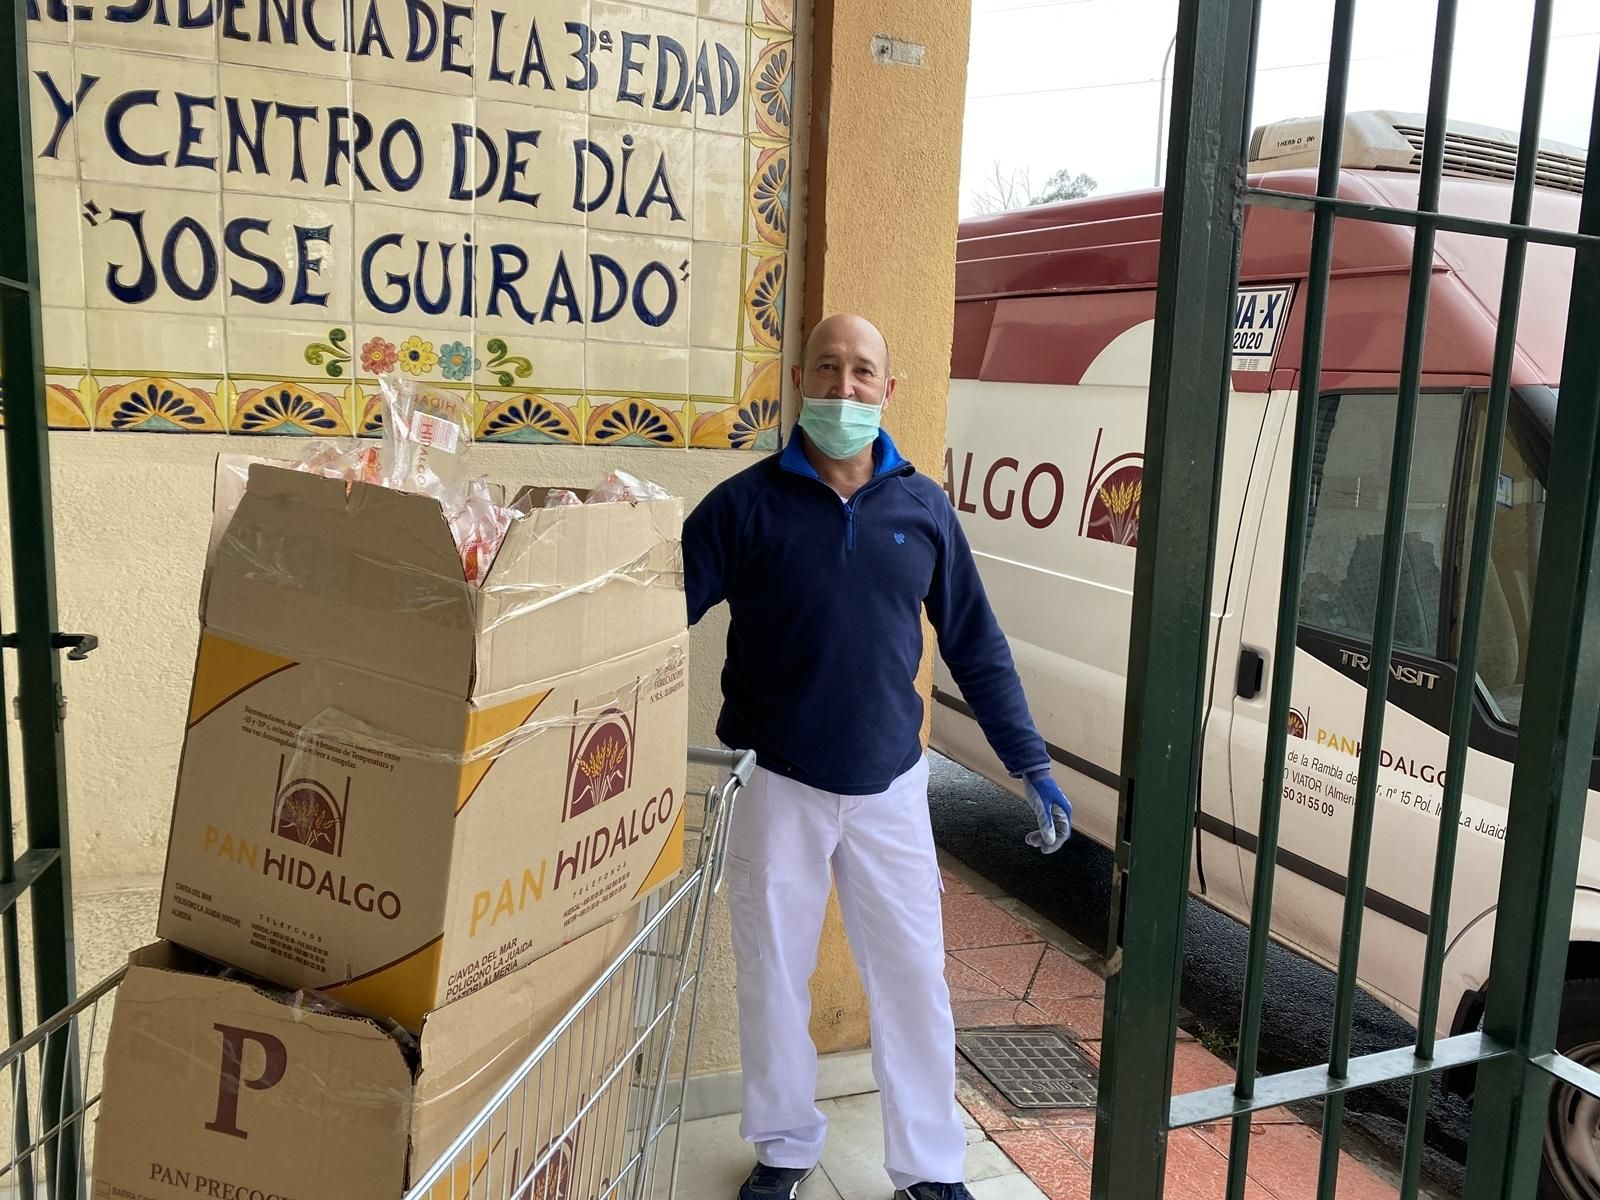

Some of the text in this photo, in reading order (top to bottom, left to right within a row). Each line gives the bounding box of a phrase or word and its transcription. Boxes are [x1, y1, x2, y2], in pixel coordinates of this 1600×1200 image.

[406, 0, 473, 77] DE
[488, 10, 556, 92] LA
[616, 31, 742, 116] EDAD
[33, 70, 100, 160] Y
[104, 89, 424, 193] CENTRO
[449, 122, 542, 208] DE
[1233, 331, 1264, 350] 2020
[1339, 649, 1440, 690] TRNSIT
[1283, 786, 1334, 817] 50 31 55 09
[1287, 749, 1299, 763] de
[1301, 754, 1309, 767] la
[1311, 757, 1343, 780] Rambla
[1400, 790, 1411, 805] 15
[1413, 794, 1431, 814] Pol.
[1475, 818, 1508, 841] Juaid
[1292, 770, 1322, 793] VIATOR
[203, 825, 401, 920] PAN HIDALGO
[469, 786, 674, 939] PAN HIDALGO
[445, 939, 533, 1001] POLIGONO LA JUAIDA
[447, 937, 518, 986] C/AVDA DEL MAR
[204, 1022, 288, 1140] P
[149, 1162, 191, 1190] PAN
